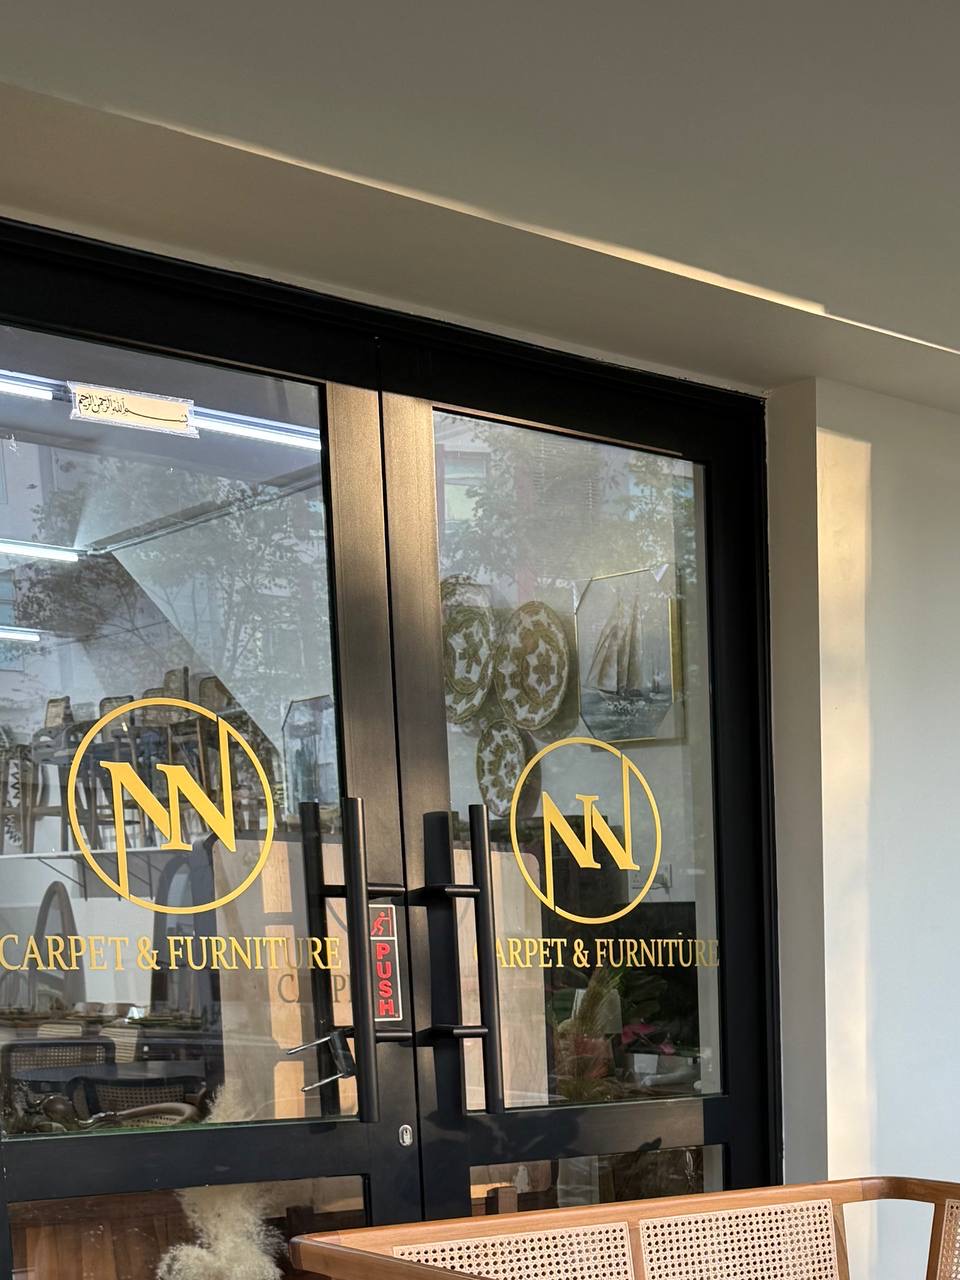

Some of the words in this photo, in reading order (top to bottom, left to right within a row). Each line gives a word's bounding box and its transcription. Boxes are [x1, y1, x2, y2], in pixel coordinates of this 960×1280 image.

[0, 934, 129, 970] CARPET
[136, 936, 161, 970] &
[167, 936, 342, 969] FURNITURE
[474, 938, 566, 969] ARPET
[573, 938, 590, 968] &
[595, 938, 720, 968] FURNITURE
[376, 943, 394, 1017] PUSH
